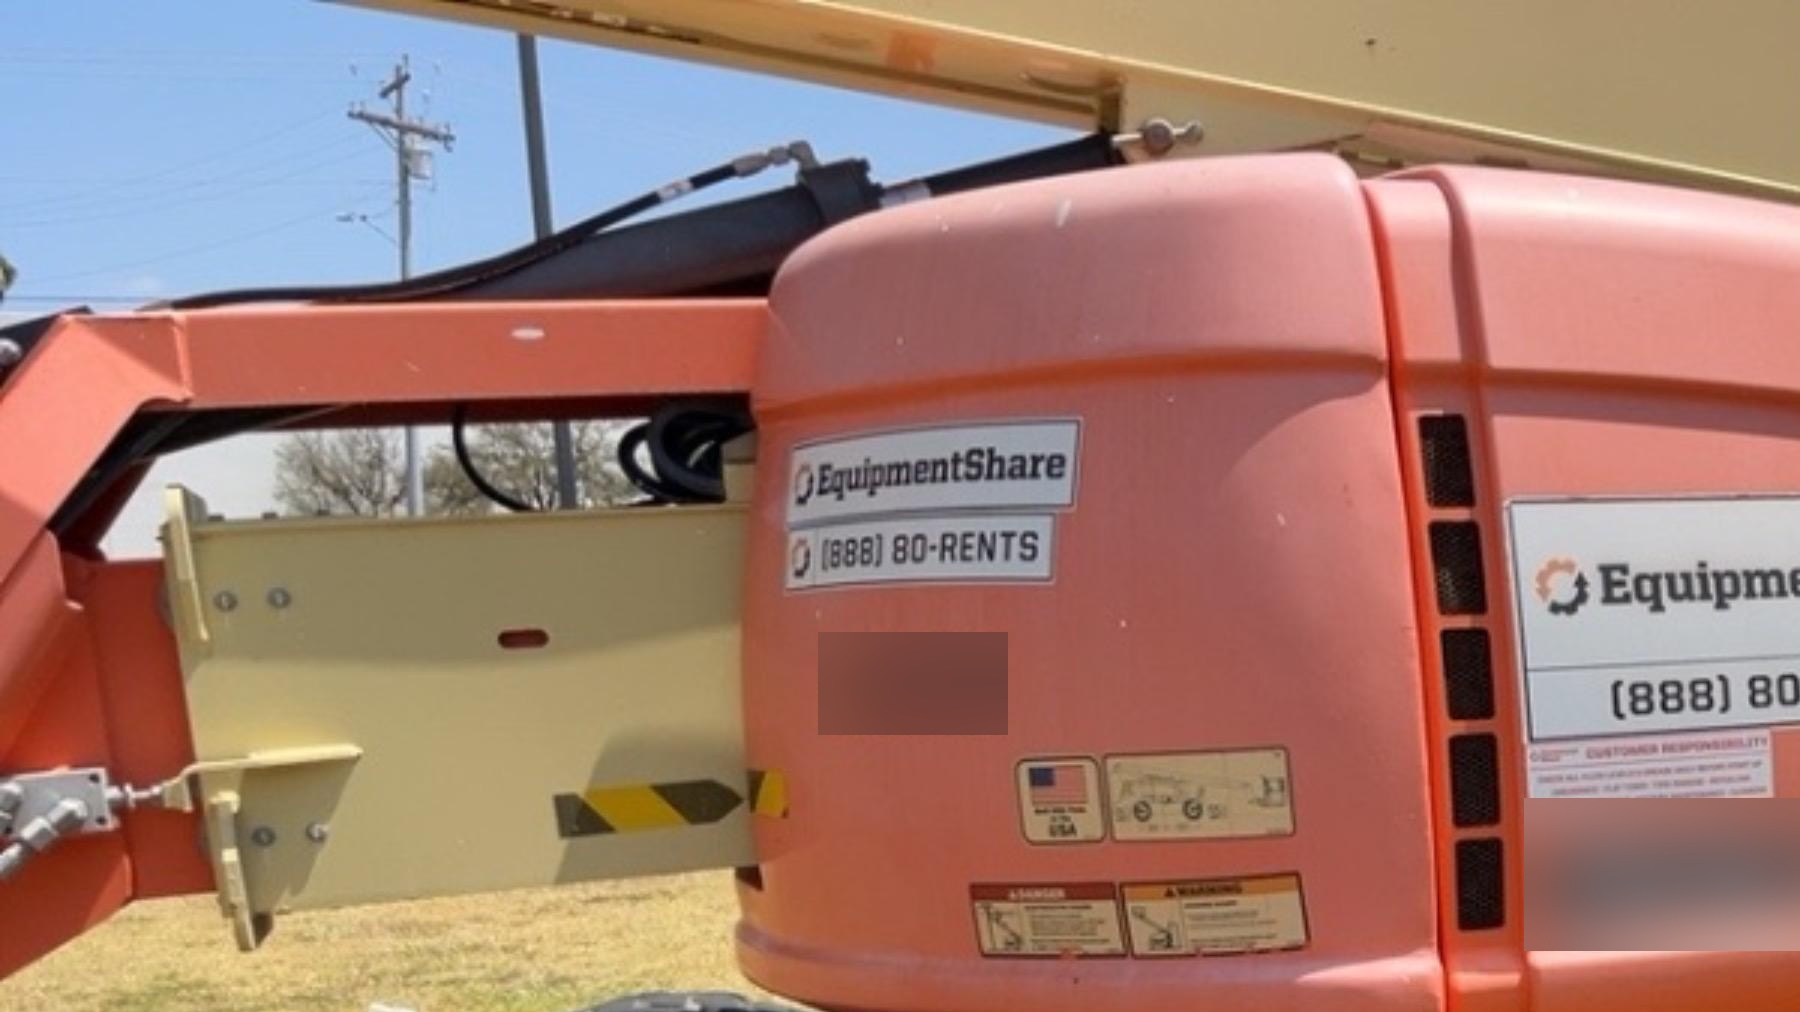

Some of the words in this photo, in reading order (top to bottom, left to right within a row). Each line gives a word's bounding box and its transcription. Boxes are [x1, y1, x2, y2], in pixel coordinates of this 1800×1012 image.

[816, 447, 1067, 500] EquipmentShare
[821, 534, 884, 571] (888)
[892, 530, 1040, 564] 80-RENTS
[1611, 675, 1732, 719] (888)
